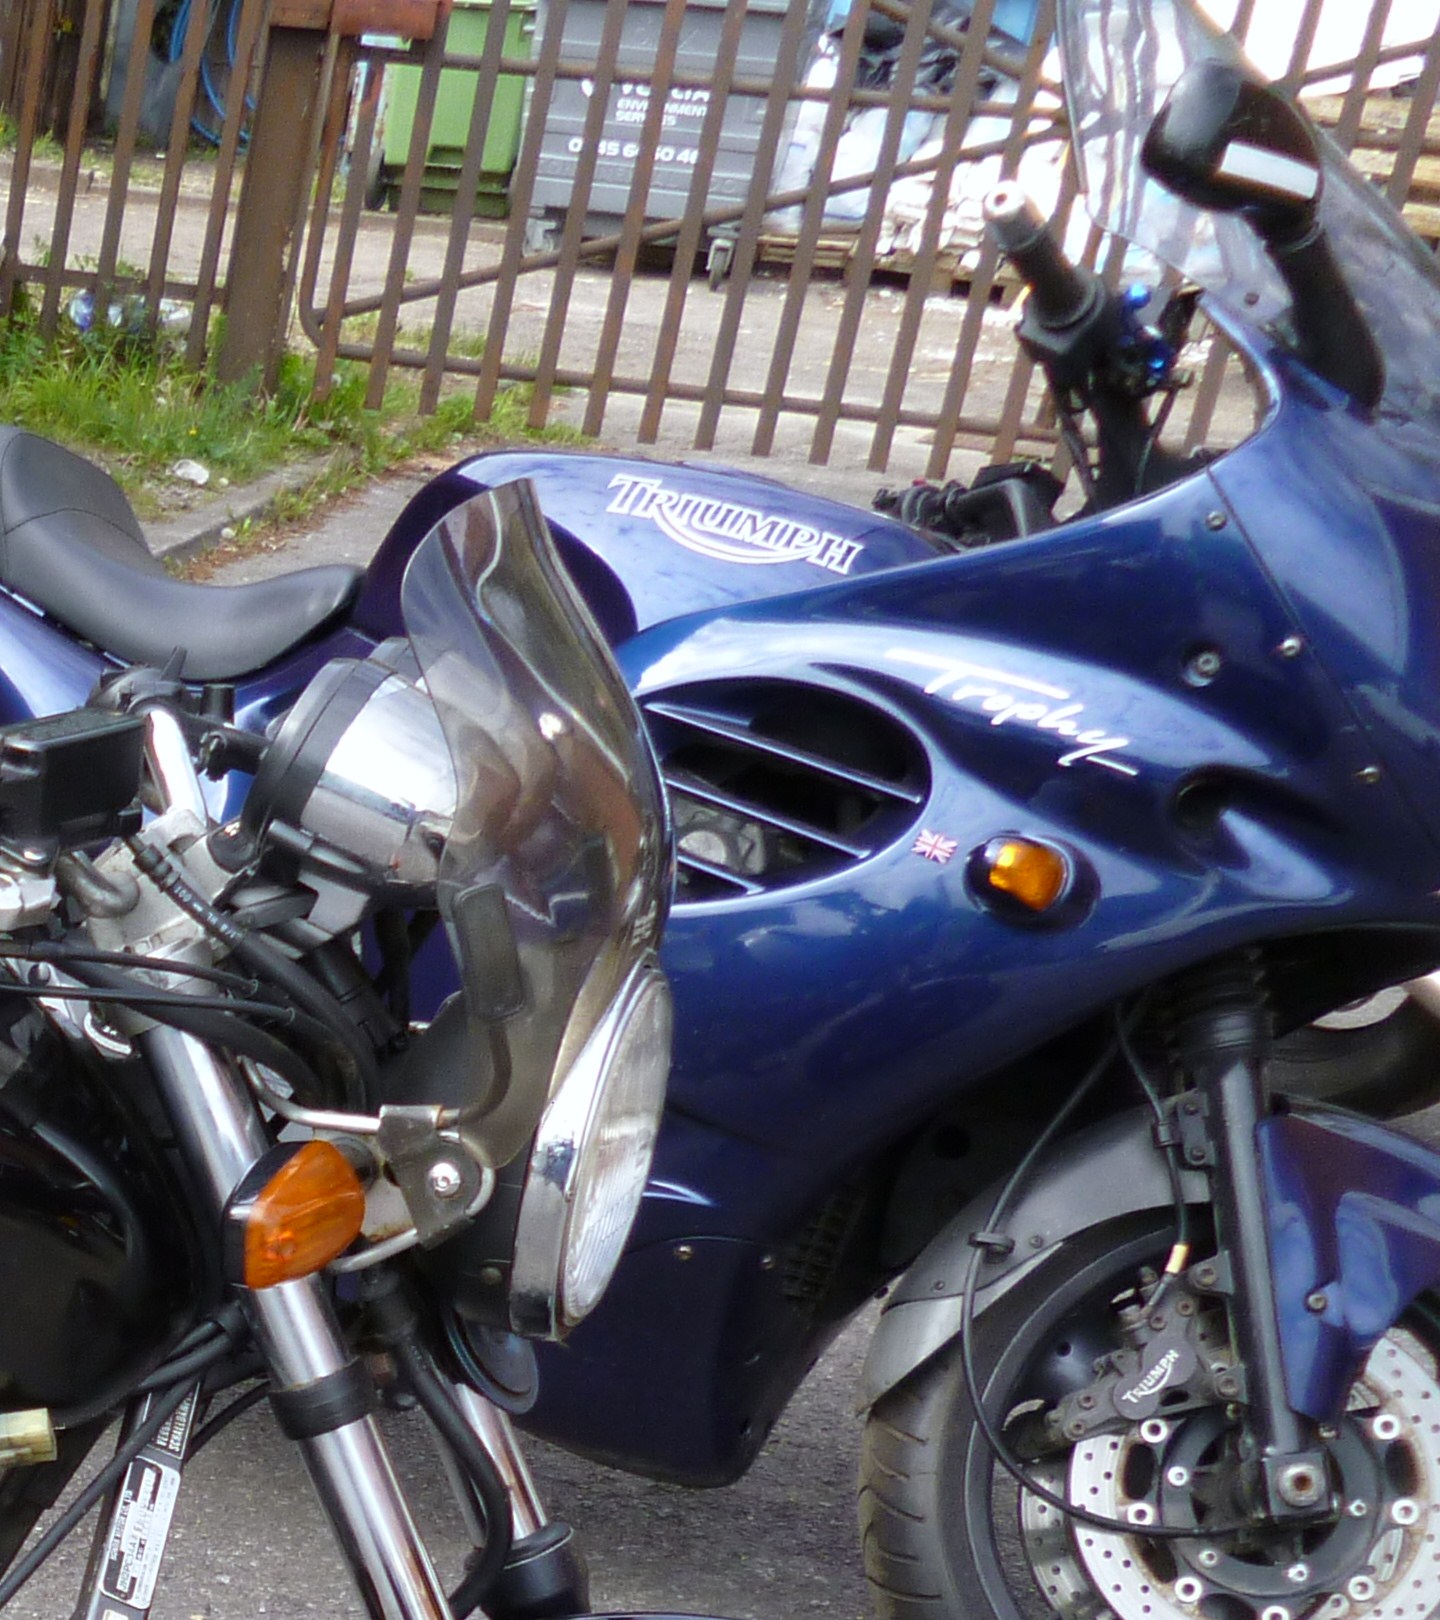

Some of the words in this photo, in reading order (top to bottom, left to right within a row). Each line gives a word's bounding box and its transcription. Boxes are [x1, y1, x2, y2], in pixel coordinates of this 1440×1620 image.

[607, 473, 864, 575] TRIUMPH
[884, 649, 1138, 772] Trophy
[1121, 1349, 1180, 1404] TRIUMPH
